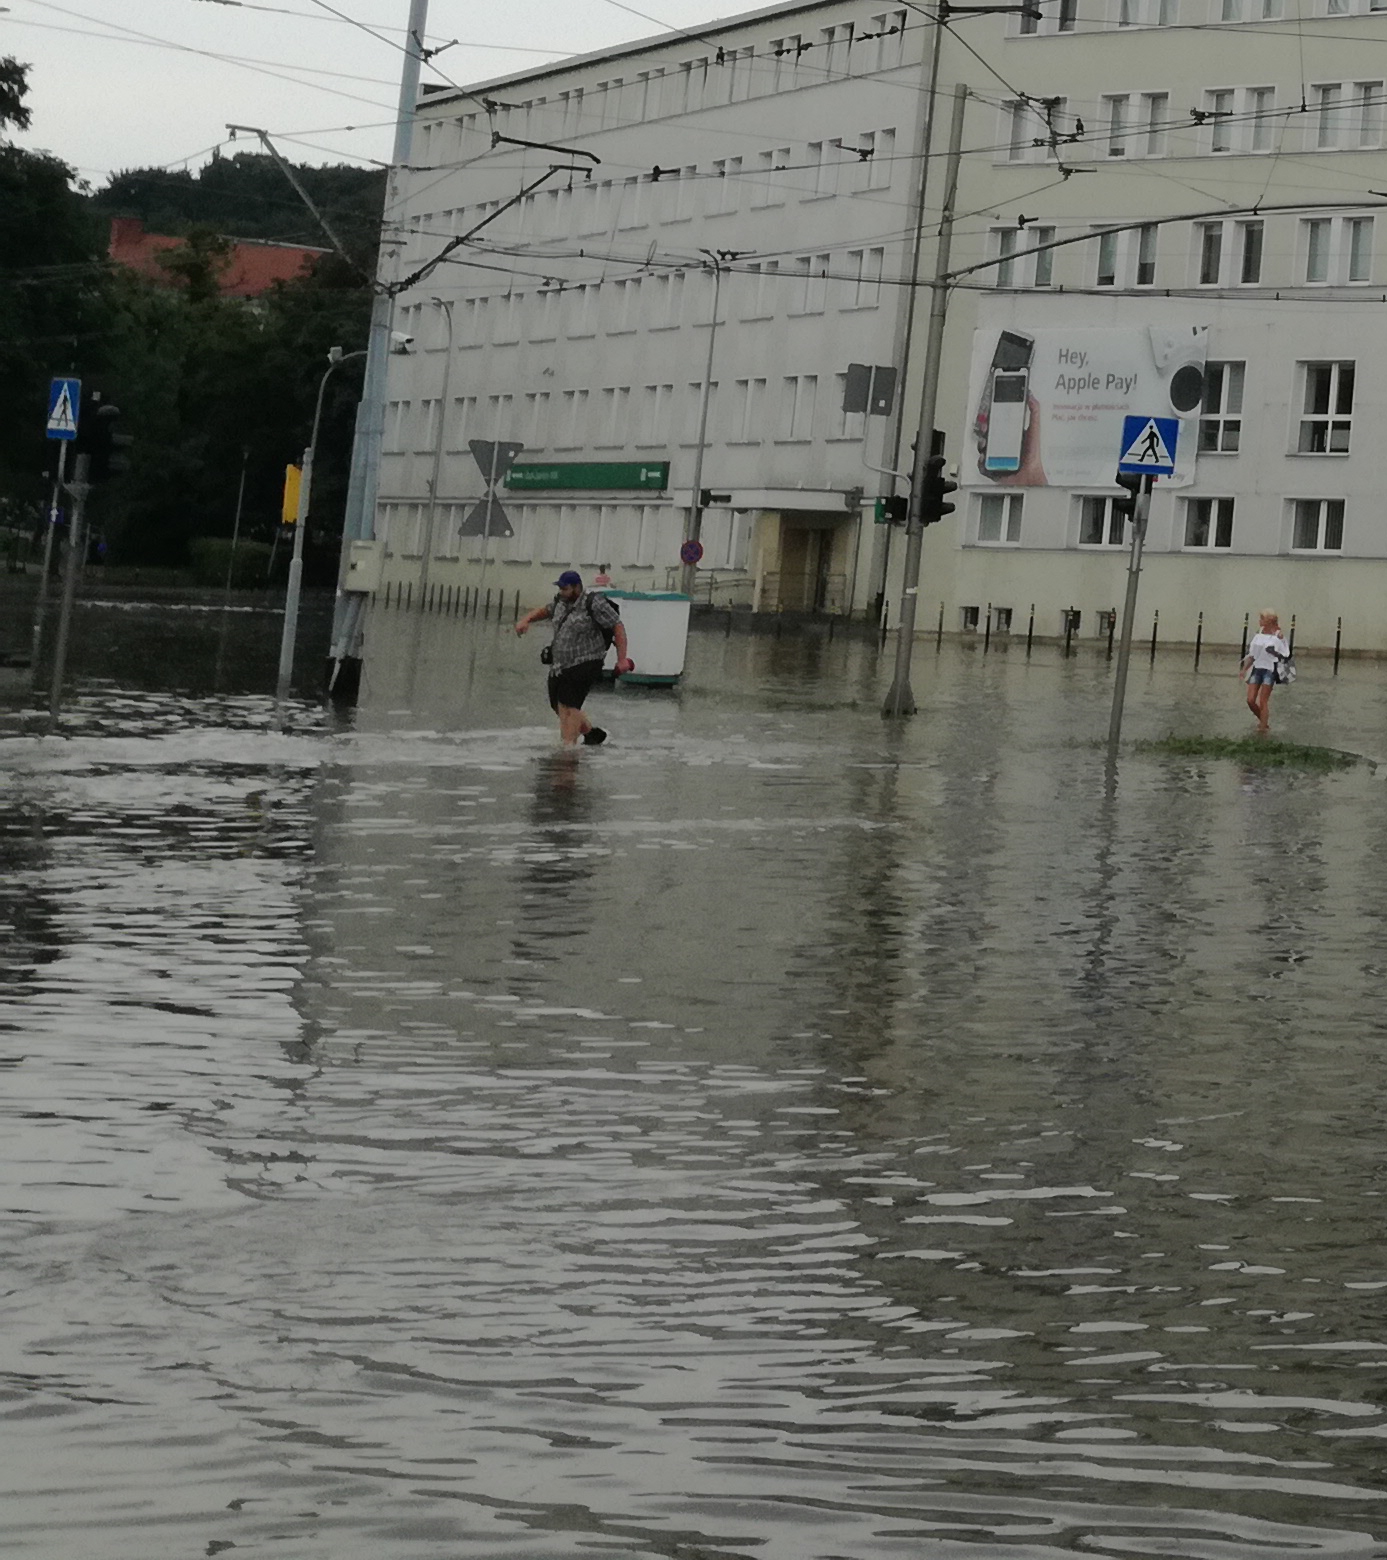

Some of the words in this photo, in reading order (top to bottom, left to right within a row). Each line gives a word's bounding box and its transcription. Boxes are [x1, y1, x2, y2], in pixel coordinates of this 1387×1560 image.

[1058, 348, 1089, 369] Hey,
[1054, 372, 1100, 395] Apple
[1105, 373, 1138, 395] Pay!
